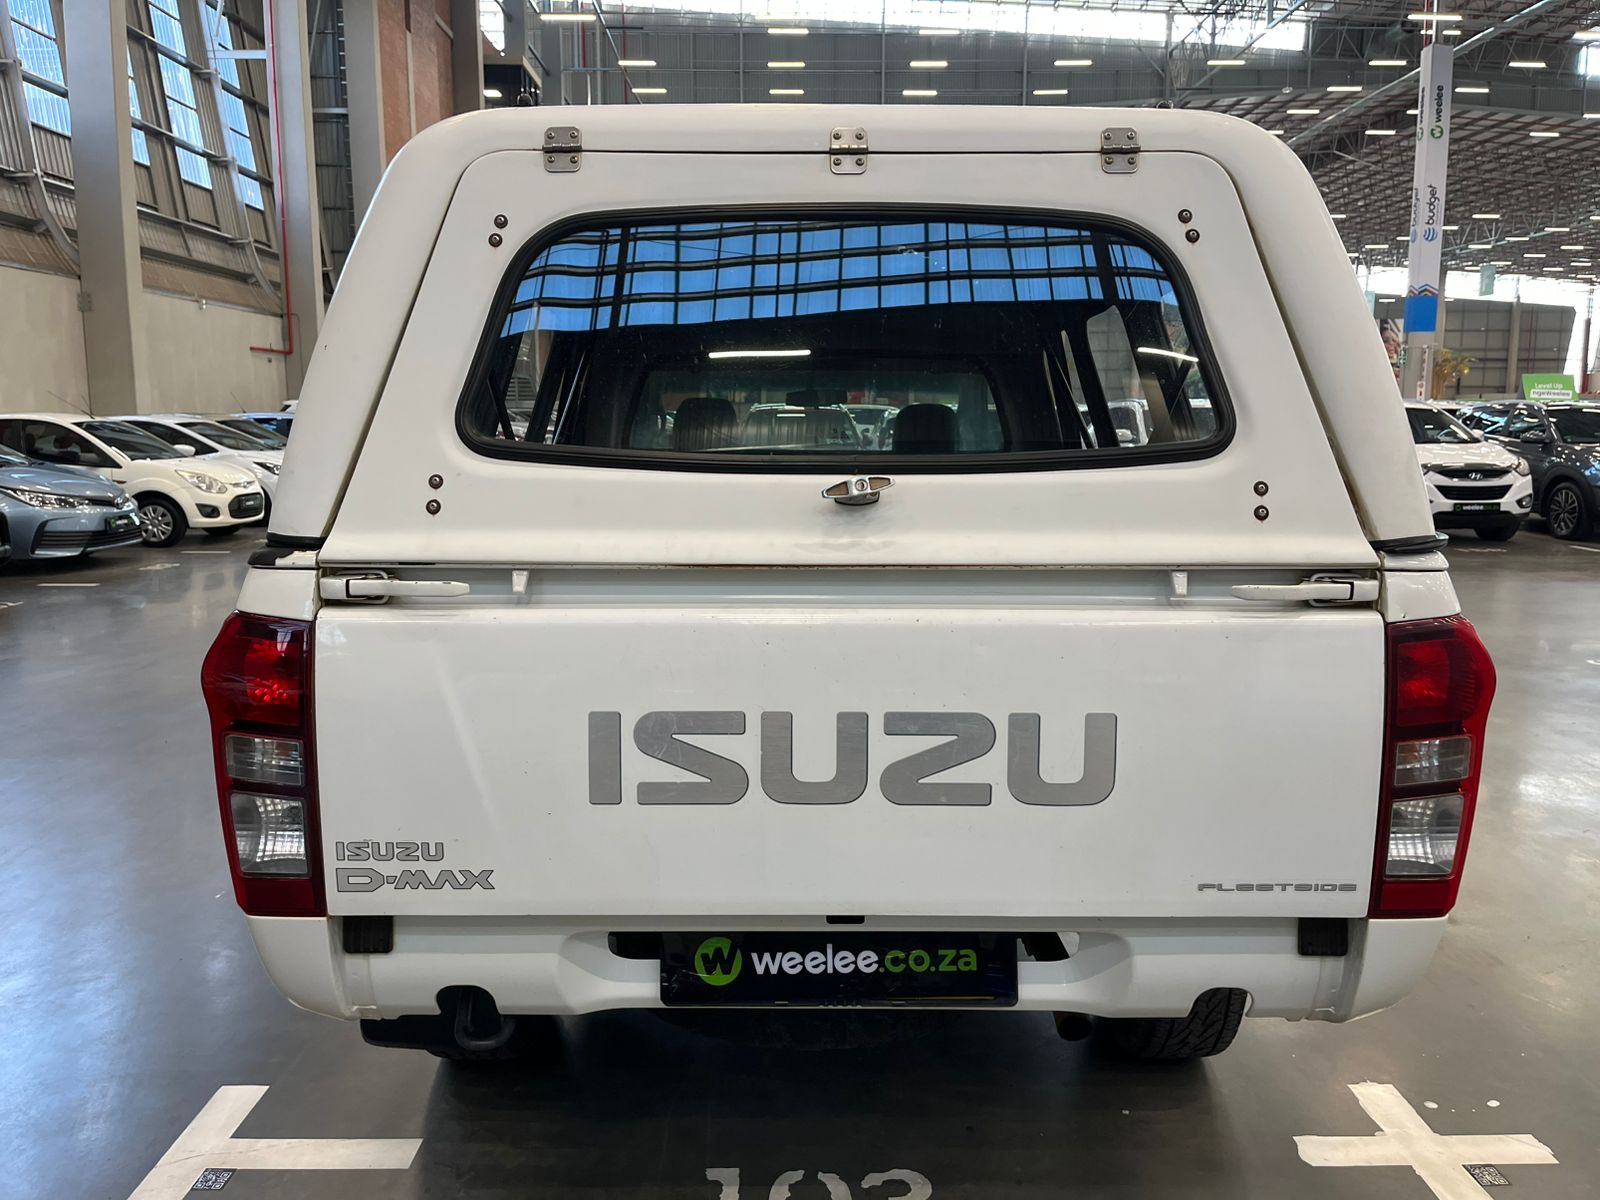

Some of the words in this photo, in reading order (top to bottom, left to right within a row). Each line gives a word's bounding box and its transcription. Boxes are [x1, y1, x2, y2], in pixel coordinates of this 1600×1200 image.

[1435, 85, 1444, 123] weelee
[1425, 184, 1440, 225] budget
[588, 711, 1118, 807] ISUZU
[335, 841, 445, 862] ISUZU
[335, 867, 496, 893] D-MAX
[1197, 882, 1358, 893] FLEETSIDE
[750, 943, 978, 975] weelee.co.za
